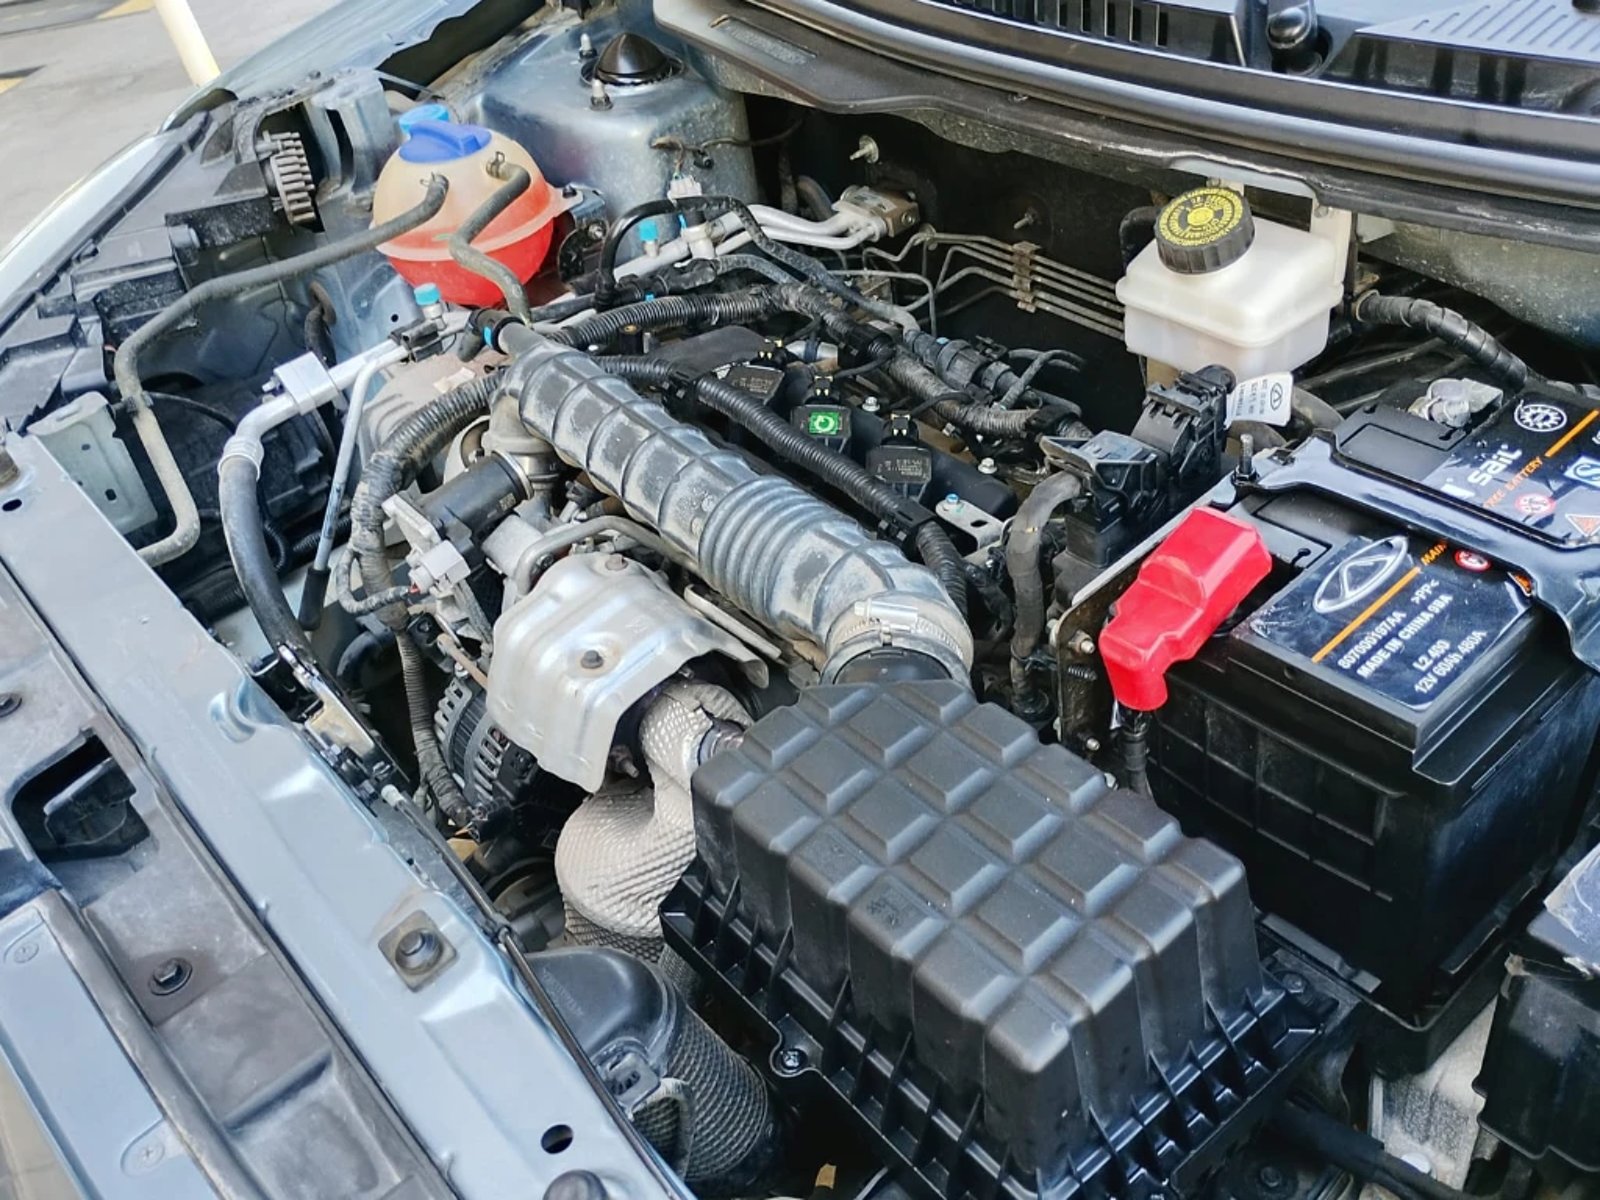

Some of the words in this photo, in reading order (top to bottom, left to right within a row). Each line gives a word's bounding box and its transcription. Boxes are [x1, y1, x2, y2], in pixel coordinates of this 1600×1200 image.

[1468, 444, 1522, 486] sail
[1504, 456, 1543, 491] BATTERY
[1356, 648, 1391, 678] MADE
[1384, 637, 1403, 653] IN
[1398, 611, 1434, 640] CHINA
[1412, 653, 1433, 672] L2
[1414, 671, 1438, 694] 12V
[1433, 651, 1463, 677] 60Ah
